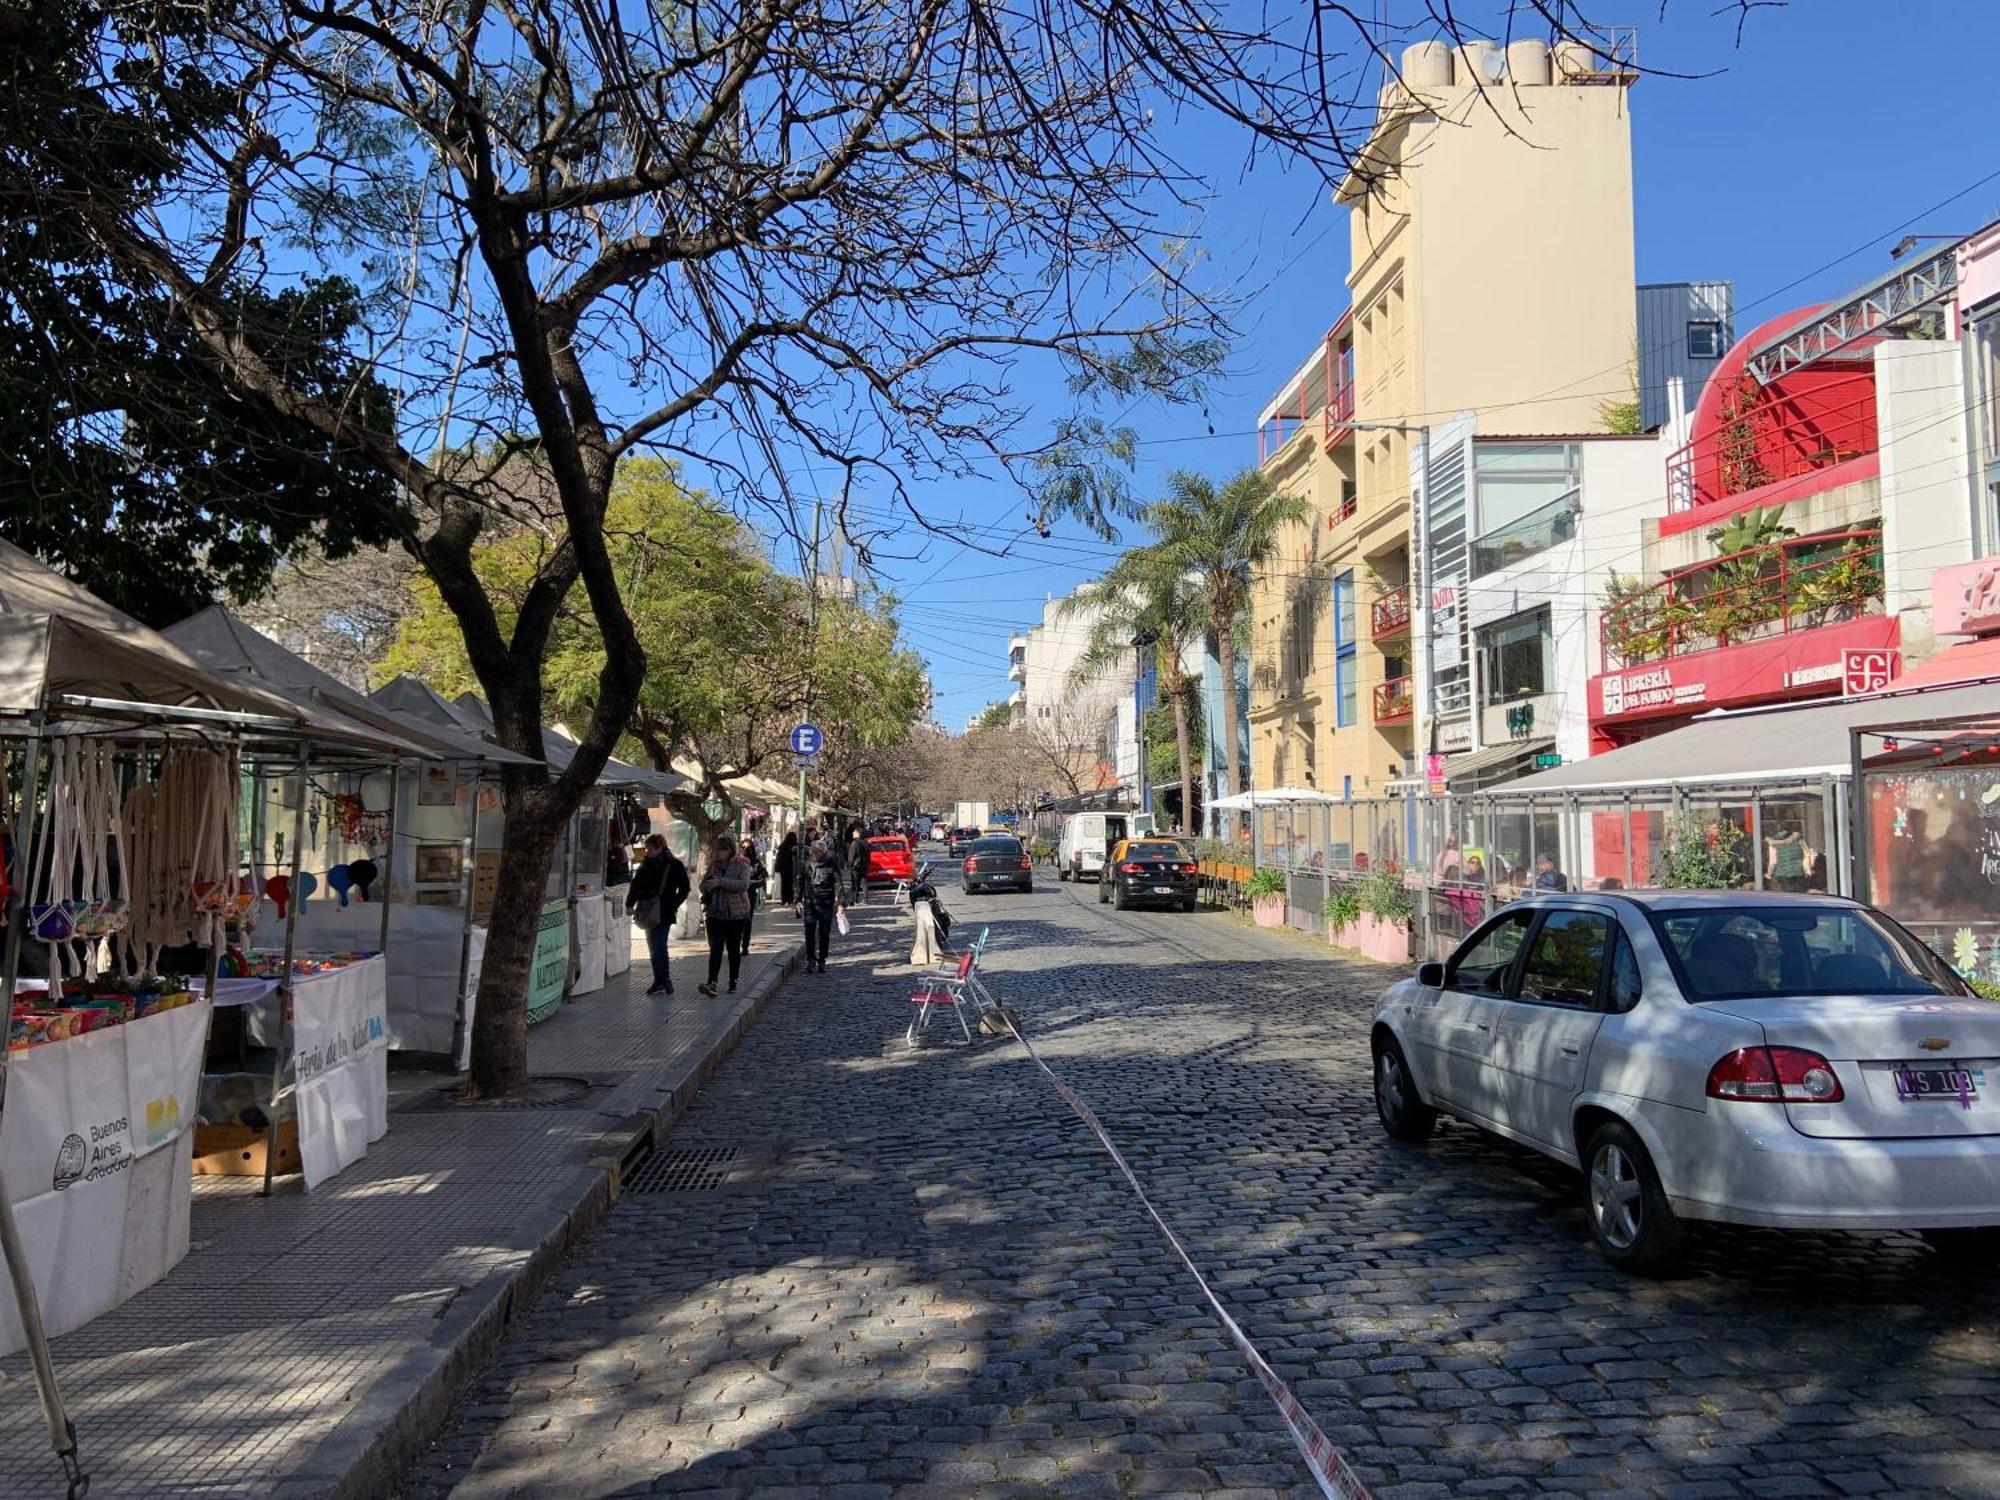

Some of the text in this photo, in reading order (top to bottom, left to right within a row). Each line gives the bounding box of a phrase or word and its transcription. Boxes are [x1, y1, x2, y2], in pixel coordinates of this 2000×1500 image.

[799, 729, 814, 751] E
[90, 1117, 128, 1143] Buenos
[91, 1142, 122, 1164] Aires
